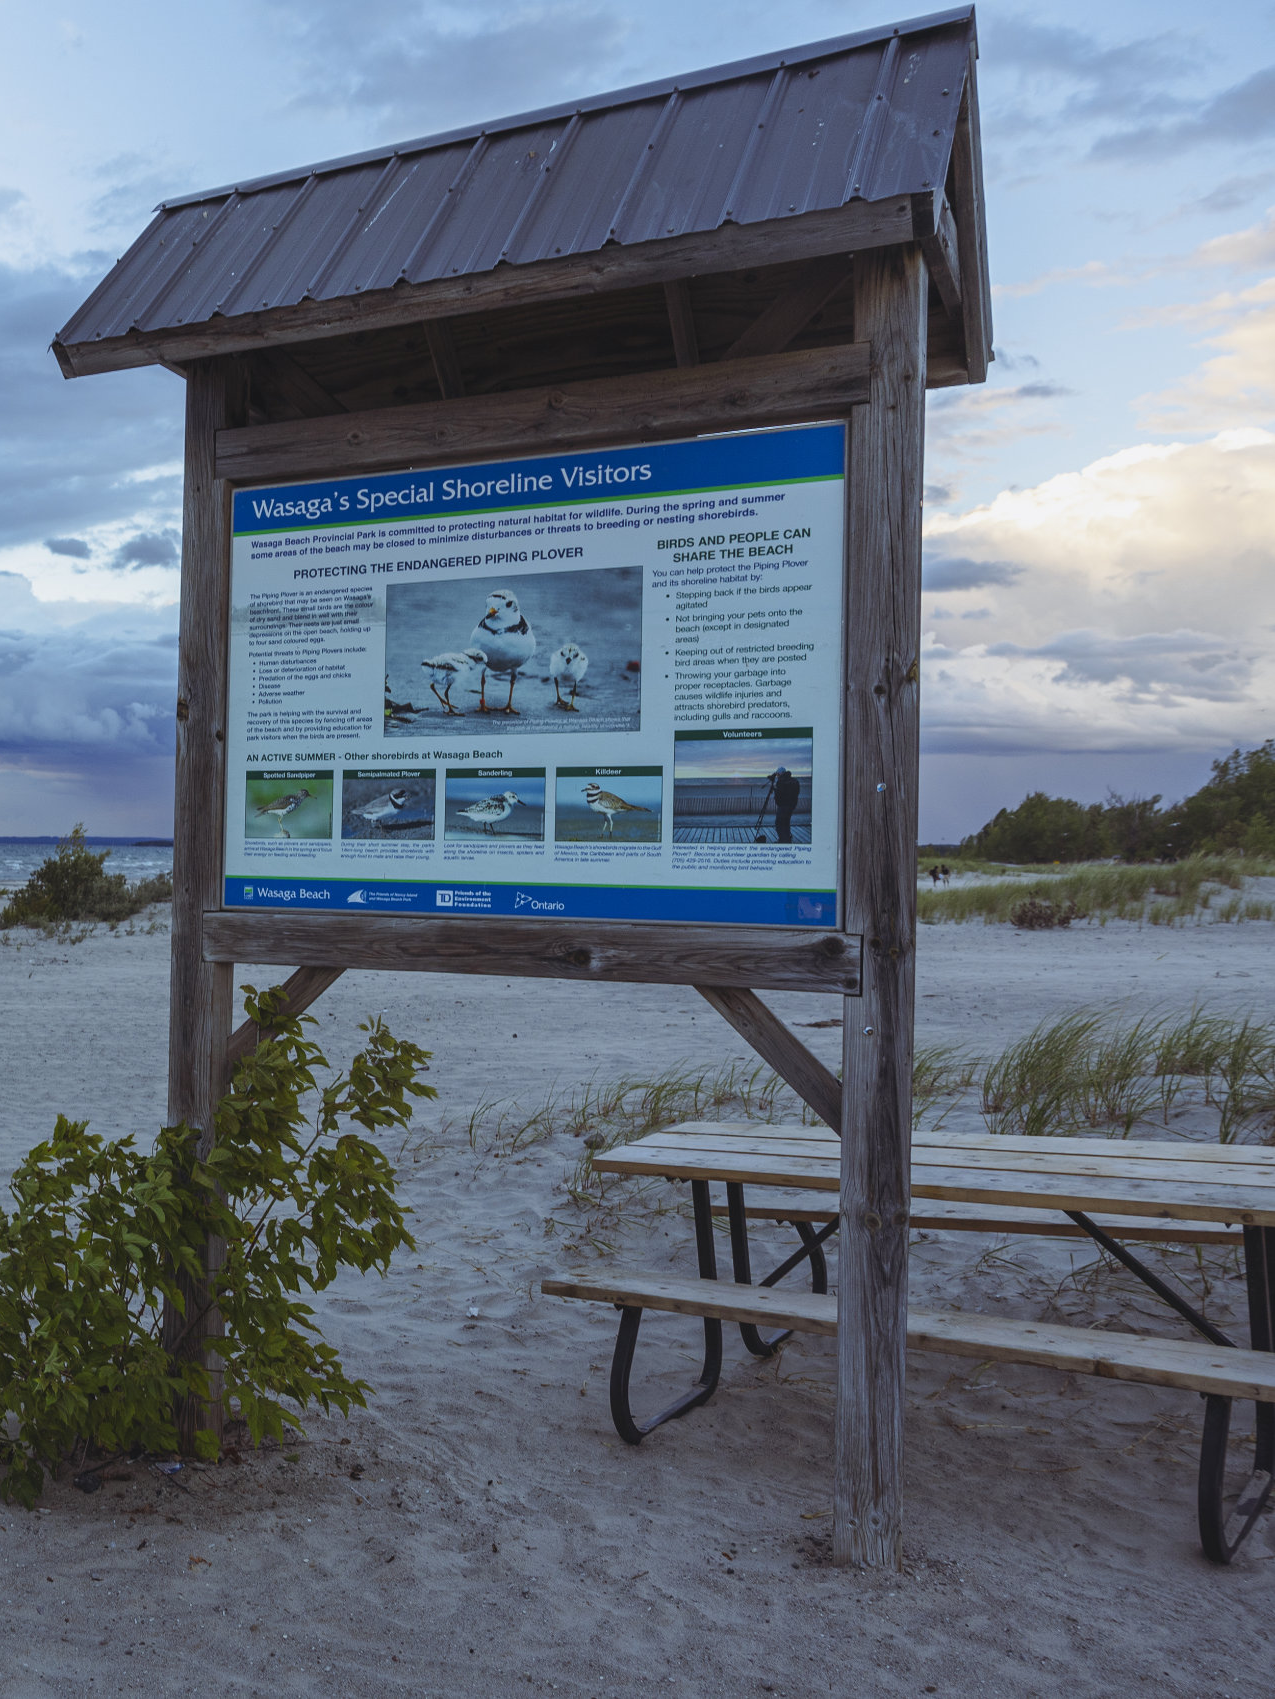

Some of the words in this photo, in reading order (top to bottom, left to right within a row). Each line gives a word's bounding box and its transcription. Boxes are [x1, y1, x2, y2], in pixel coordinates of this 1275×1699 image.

[252, 491, 350, 519] Wasaga's
[356, 482, 434, 513] Special
[442, 473, 553, 500] Shoreline
[560, 464, 652, 488] Visitors
[251, 540, 283, 549] Wasaga
[284, 536, 311, 546] Beach
[312, 532, 355, 543] Provincial
[357, 530, 376, 539] Park
[388, 524, 435, 537] committed
[448, 520, 496, 533] protecting
[498, 515, 531, 527] natural
[533, 513, 566, 524] habitat
[569, 511, 583, 520] for
[585, 508, 623, 519] wildlife.
[626, 505, 660, 515] During
[663, 503, 680, 512] the
[682, 499, 716, 512] spring
[718, 496, 738, 507] and
[741, 493, 785, 505] summer
[251, 552, 273, 560] some
[274, 550, 297, 558] areas
[310, 547, 324, 555] the
[325, 543, 351, 553] beach
[353, 543, 371, 552] may
[386, 537, 415, 548] closed
[428, 533, 470, 544] minimize
[471, 529, 532, 541] disturbances
[547, 524, 581, 534] threats
[596, 518, 640, 530] breeding
[656, 514, 695, 525] nesting
[698, 508, 758, 521] shorebirds.
[657, 537, 695, 550] BIRDS
[698, 535, 725, 547] AND
[729, 530, 780, 544] PEOPLE
[783, 527, 811, 540] CAN
[673, 550, 716, 563] SHARE
[719, 547, 744, 559] THE
[748, 544, 793, 557] BEACH
[293, 564, 367, 580] PROTECTING
[370, 562, 394, 573] THE
[397, 555, 482, 572] ENDANGERED
[485, 551, 528, 565] PIPING
[531, 547, 583, 561] PLOVER
[652, 569, 668, 577] You
[669, 569, 685, 577] can
[686, 566, 705, 576] help
[706, 564, 735, 575] protect
[737, 563, 752, 572] the
[753, 562, 780, 571] Piping
[782, 560, 808, 568] Plover
[651, 579, 667, 588] and
[669, 579, 679, 587] its
[681, 577, 718, 586] shoreline
[719, 574, 748, 583] habitat
[750, 573, 763, 583] by:
[676, 590, 712, 600] Stepping
[714, 588, 734, 597] back
[743, 587, 757, 595] the
[759, 585, 780, 594] birds
[782, 584, 812, 593] appear
[675, 600, 708, 611] agitated
[675, 615, 690, 623] Not
[692, 613, 725, 622] bringing
[727, 613, 745, 622] your
[747, 611, 766, 620] pets
[767, 609, 787, 618] onto
[789, 608, 803, 616] the
[675, 625, 700, 633] beach
[702, 623, 732, 632] (except
[743, 619, 790, 630] designated
[675, 634, 700, 644] areas)
[675, 648, 708, 657] Keeping
[709, 647, 723, 655] out
[735, 644, 775, 653] restricted
[777, 642, 815, 652] breeding
[674, 659, 691, 667] bird
[717, 657, 740, 665] when
[741, 656, 760, 665] they
[777, 653, 807, 664] posted
[675, 672, 712, 680] Throwing
[713, 671, 732, 680] your
[733, 669, 769, 679] garbage
[770, 668, 787, 676] into
[674, 683, 701, 692] proper
[703, 680, 752, 690] receptacles.
[755, 679, 792, 688] Garbage
[674, 693, 703, 701] causes
[705, 691, 733, 699] wildlife
[734, 691, 764, 700] injuries
[766, 689, 782, 697] and
[674, 703, 705, 711] attracts
[707, 701, 746, 710] shorebird
[747, 700, 790, 711] predators,
[674, 713, 710, 723] including
[711, 712, 731, 722] gulls
[733, 711, 750, 720] and
[261, 753, 292, 762] ACTIVE
[294, 752, 336, 762] SUMMER
[344, 752, 370, 761] Other
[371, 751, 419, 760] shorebirds
[433, 750, 470, 760] Wasaga
[472, 750, 503, 759] Beach
[478, 769, 513, 777] Sanderling
[257, 887, 297, 901] Wasaga
[299, 888, 330, 900] Beach
[530, 900, 565, 911] Ontario
